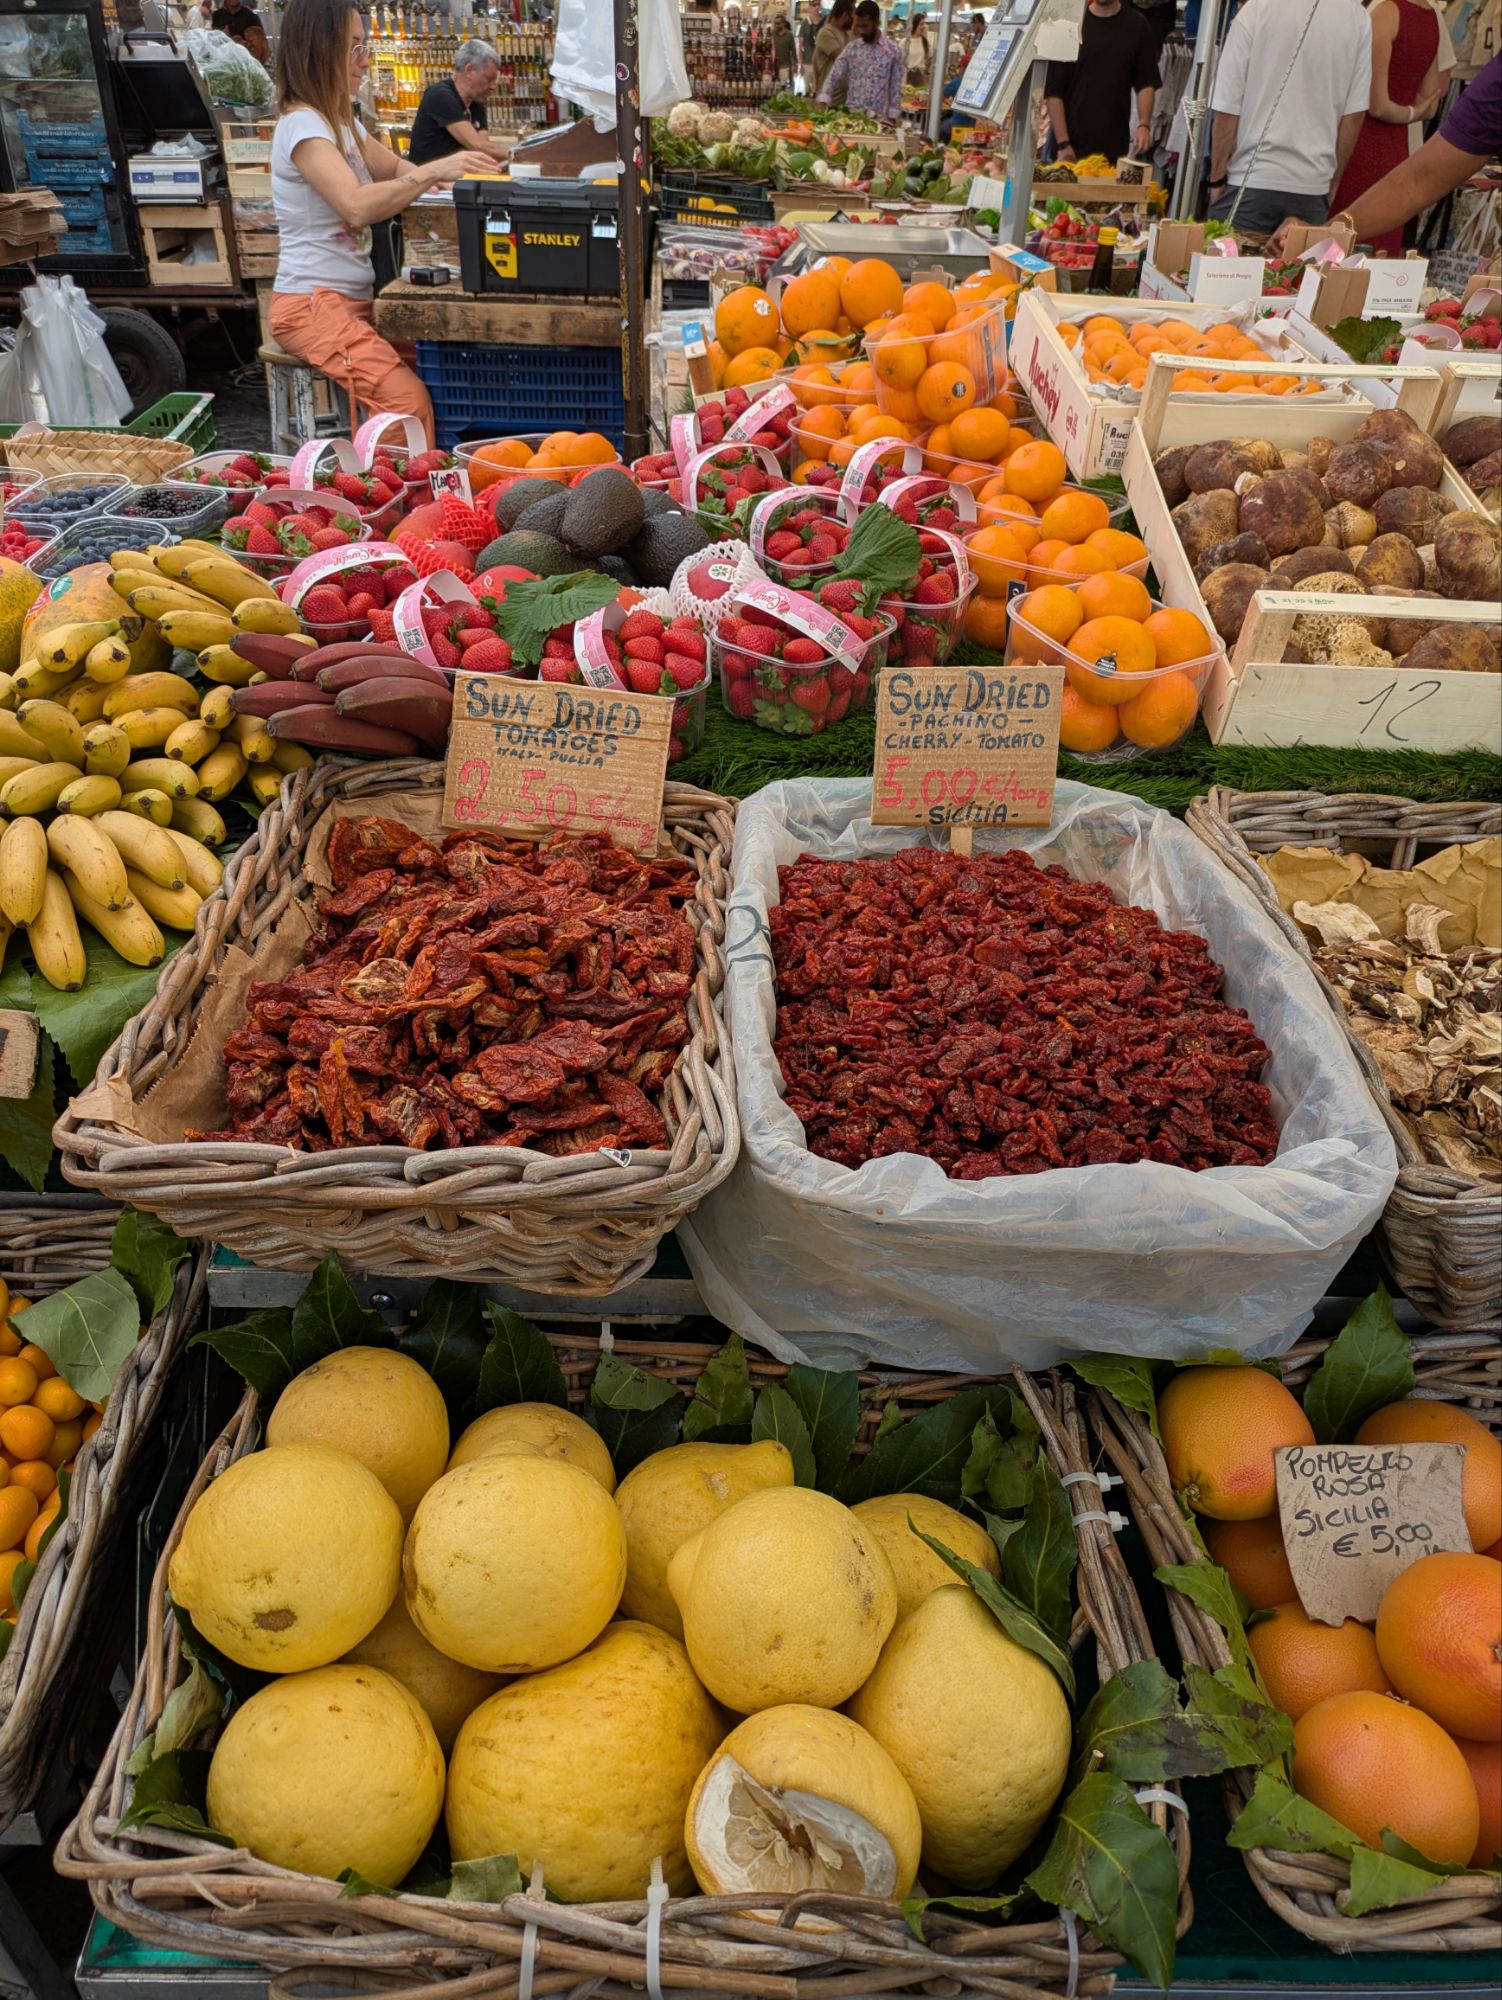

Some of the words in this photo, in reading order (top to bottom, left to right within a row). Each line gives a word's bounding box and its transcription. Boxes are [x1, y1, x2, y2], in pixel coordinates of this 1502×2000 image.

[523, 232, 581, 247] STANLEY
[333, 548, 370, 567] Candy
[749, 590, 781, 610] Candy
[888, 672, 958, 716] SUN
[962, 670, 1051, 713] DRIED
[551, 691, 641, 736] DRIED
[910, 713, 1008, 731] PACHINO
[1357, 680, 1442, 742] 12
[490, 723, 619, 756] TOMATOES
[550, 750, 604, 769] PUGLIA
[454, 758, 577, 828] 2,50
[880, 757, 978, 809] 5,00
[928, 801, 1008, 825] SICILIA
[1312, 1472, 1385, 1500] ROSA
[1295, 1496, 1389, 1537] SICILIA
